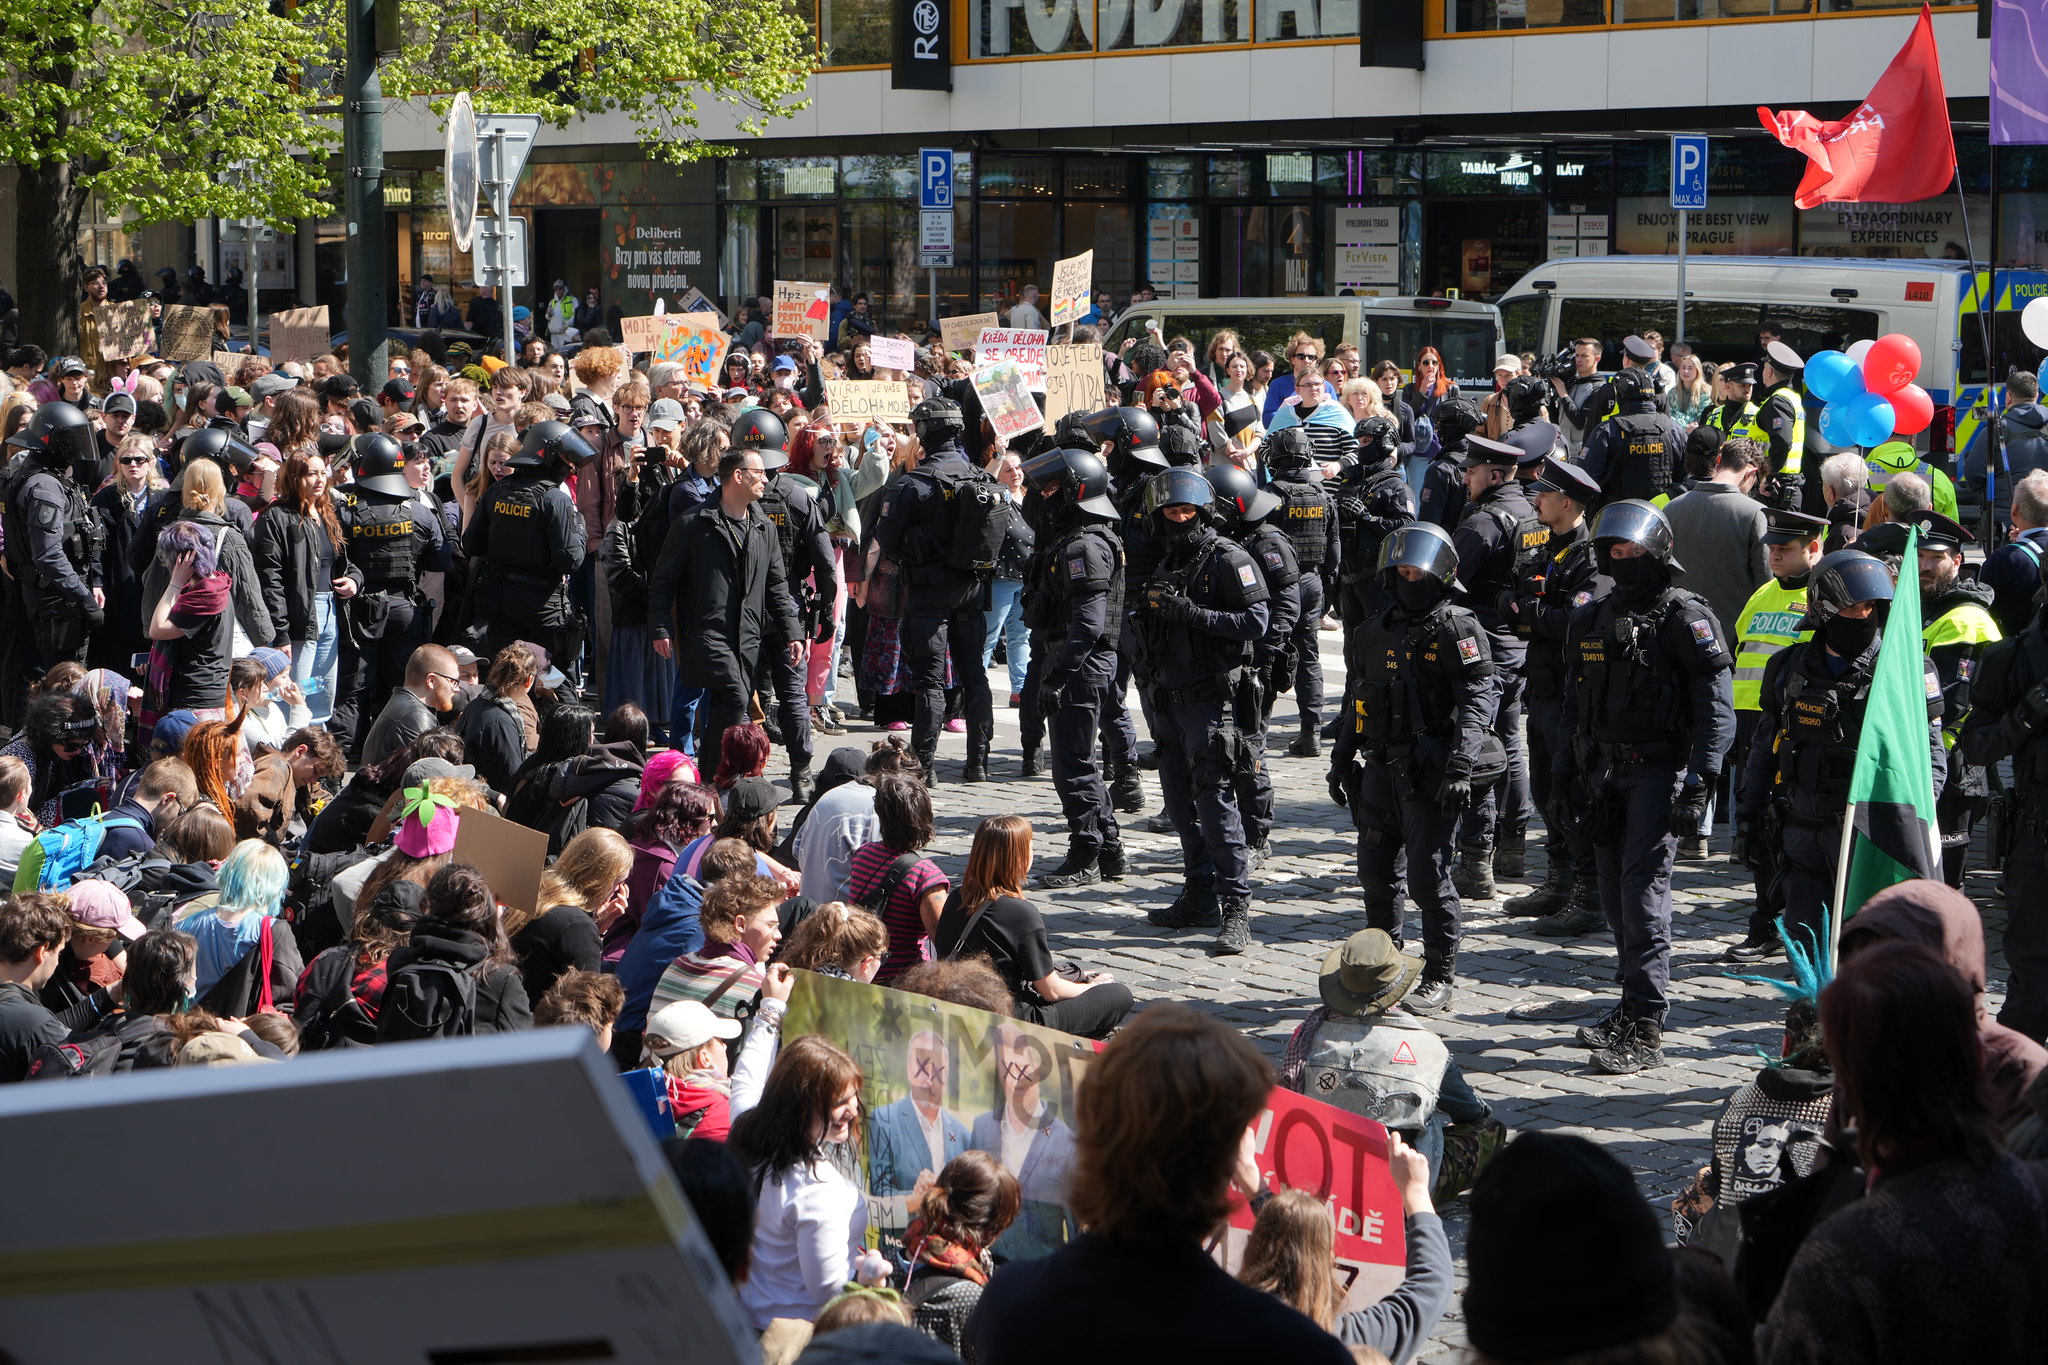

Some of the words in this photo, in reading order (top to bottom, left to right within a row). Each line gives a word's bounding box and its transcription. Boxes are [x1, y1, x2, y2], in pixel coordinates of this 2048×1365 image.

[1461, 160, 1496, 174] TABÁK
[1680, 145, 1700, 186] P
[927, 156, 946, 190] P
[1501, 172, 1511, 185] DON
[1675, 195, 1692, 205] MAX.
[1638, 214, 1676, 225] ENJOY
[1687, 214, 1704, 225] HE
[1706, 214, 1733, 225] BEST
[1737, 214, 1770, 225] VIEW
[1838, 212, 1952, 224] EXTRAORDINARY
[636, 227, 681, 239] Deliberti
[1668, 232, 1679, 243] IN
[1686, 232, 1734, 243] PRAGUE
[1851, 231, 1938, 243] EXPERIENCES
[616, 247, 632, 269] Brzy
[634, 250, 647, 269] pro
[649, 246, 662, 265] vás
[664, 246, 701, 265] otevřeme
[628, 274, 650, 289] novou
[652, 271, 689, 293] prodejnu.
[1908, 291, 1929, 300] L410
[2015, 284, 2048, 297] POLICIE
[624, 318, 652, 335] MOJE
[982, 330, 1009, 345] KAŽDÁ
[1013, 332, 1045, 345] DĚLOHA
[984, 349, 999, 361] SE
[829, 382, 861, 398] VÍRA
[872, 385, 880, 393] JE
[884, 383, 901, 393] VAŠE
[831, 395, 884, 415] DĚLOHA
[887, 400, 909, 414] MOJE
[744, 433, 765, 442] A809
[1629, 442, 1663, 454] POLICIE
[494, 501, 531, 518] POLICIE
[1289, 506, 1323, 518] POLICIE
[353, 521, 414, 538] POLICIE
[1580, 641, 1604, 649] POLICIE
[1582, 653, 1604, 661] 334010
[1795, 701, 1825, 714] POLICIE
[1799, 716, 1821, 727] 328260
